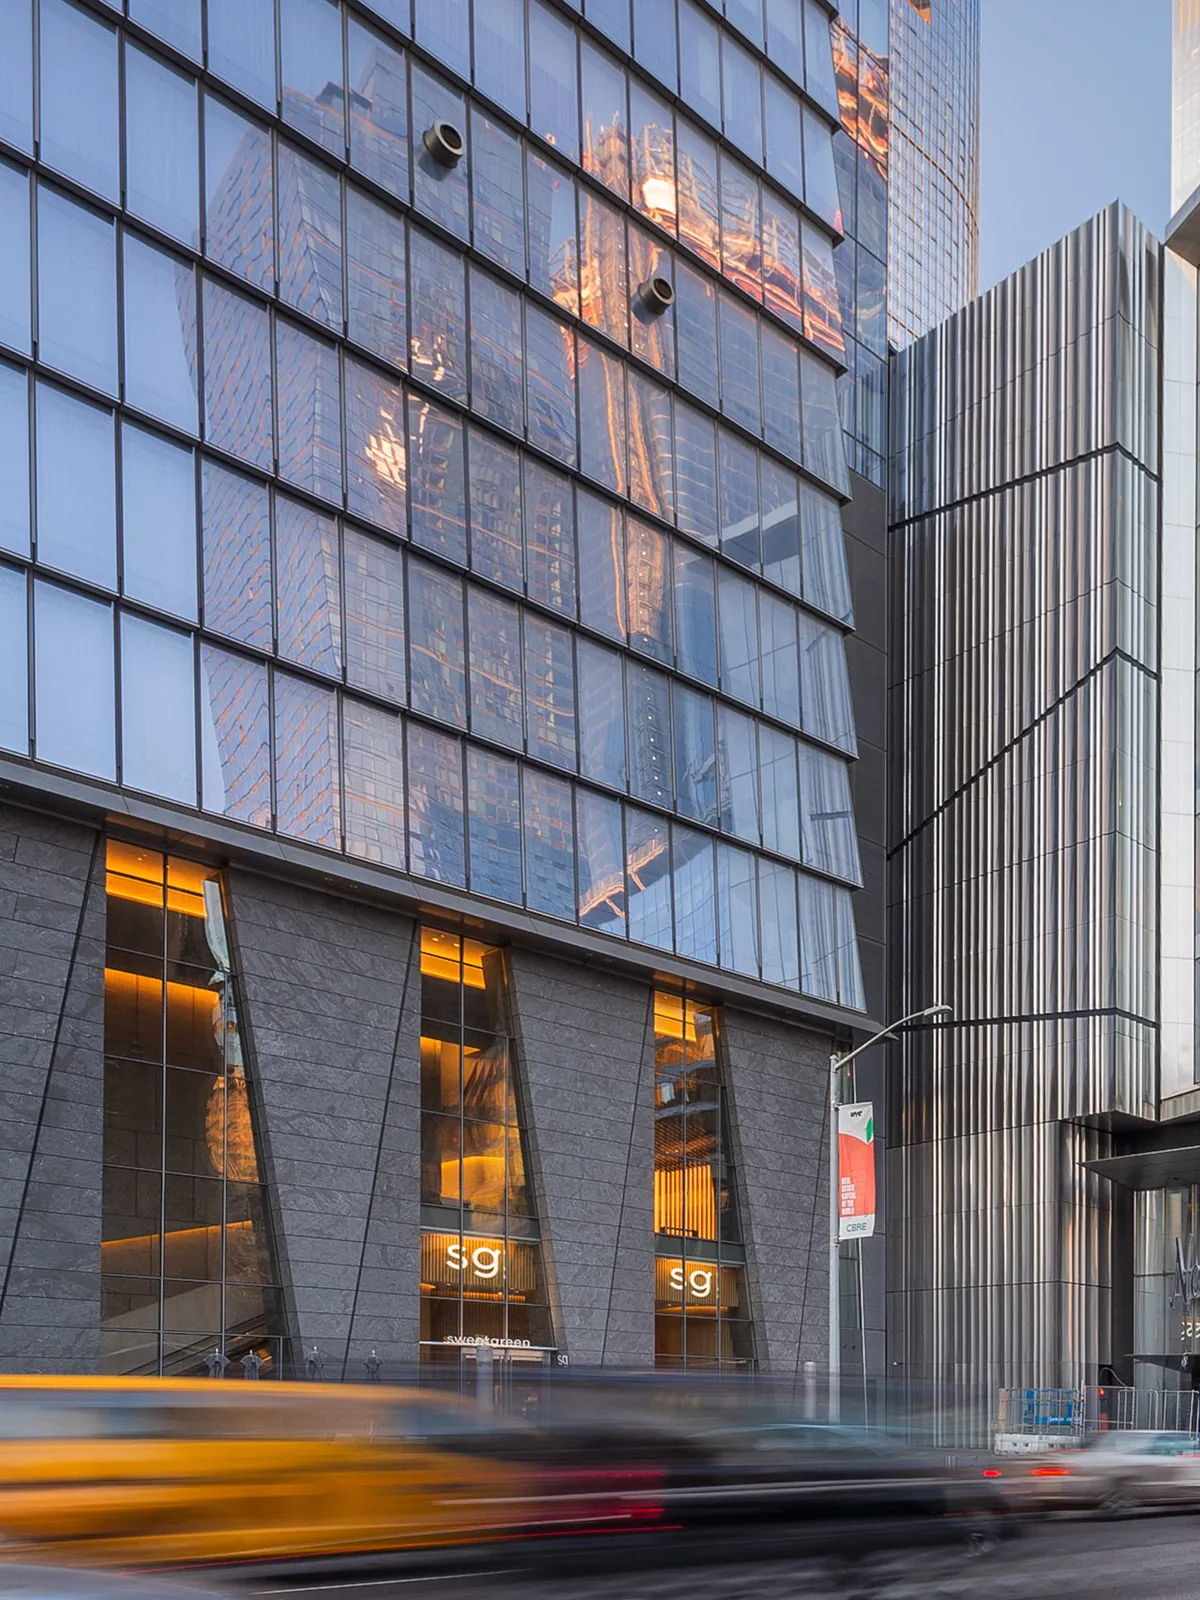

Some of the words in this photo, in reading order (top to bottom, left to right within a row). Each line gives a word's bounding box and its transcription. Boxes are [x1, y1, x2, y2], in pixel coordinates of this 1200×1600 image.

[846, 1222, 867, 1232] CBRE
[446, 1244, 501, 1279] sg
[669, 1267, 712, 1298] sg
[446, 1335, 531, 1348] sweetgreen
[557, 1354, 569, 1367] sg
